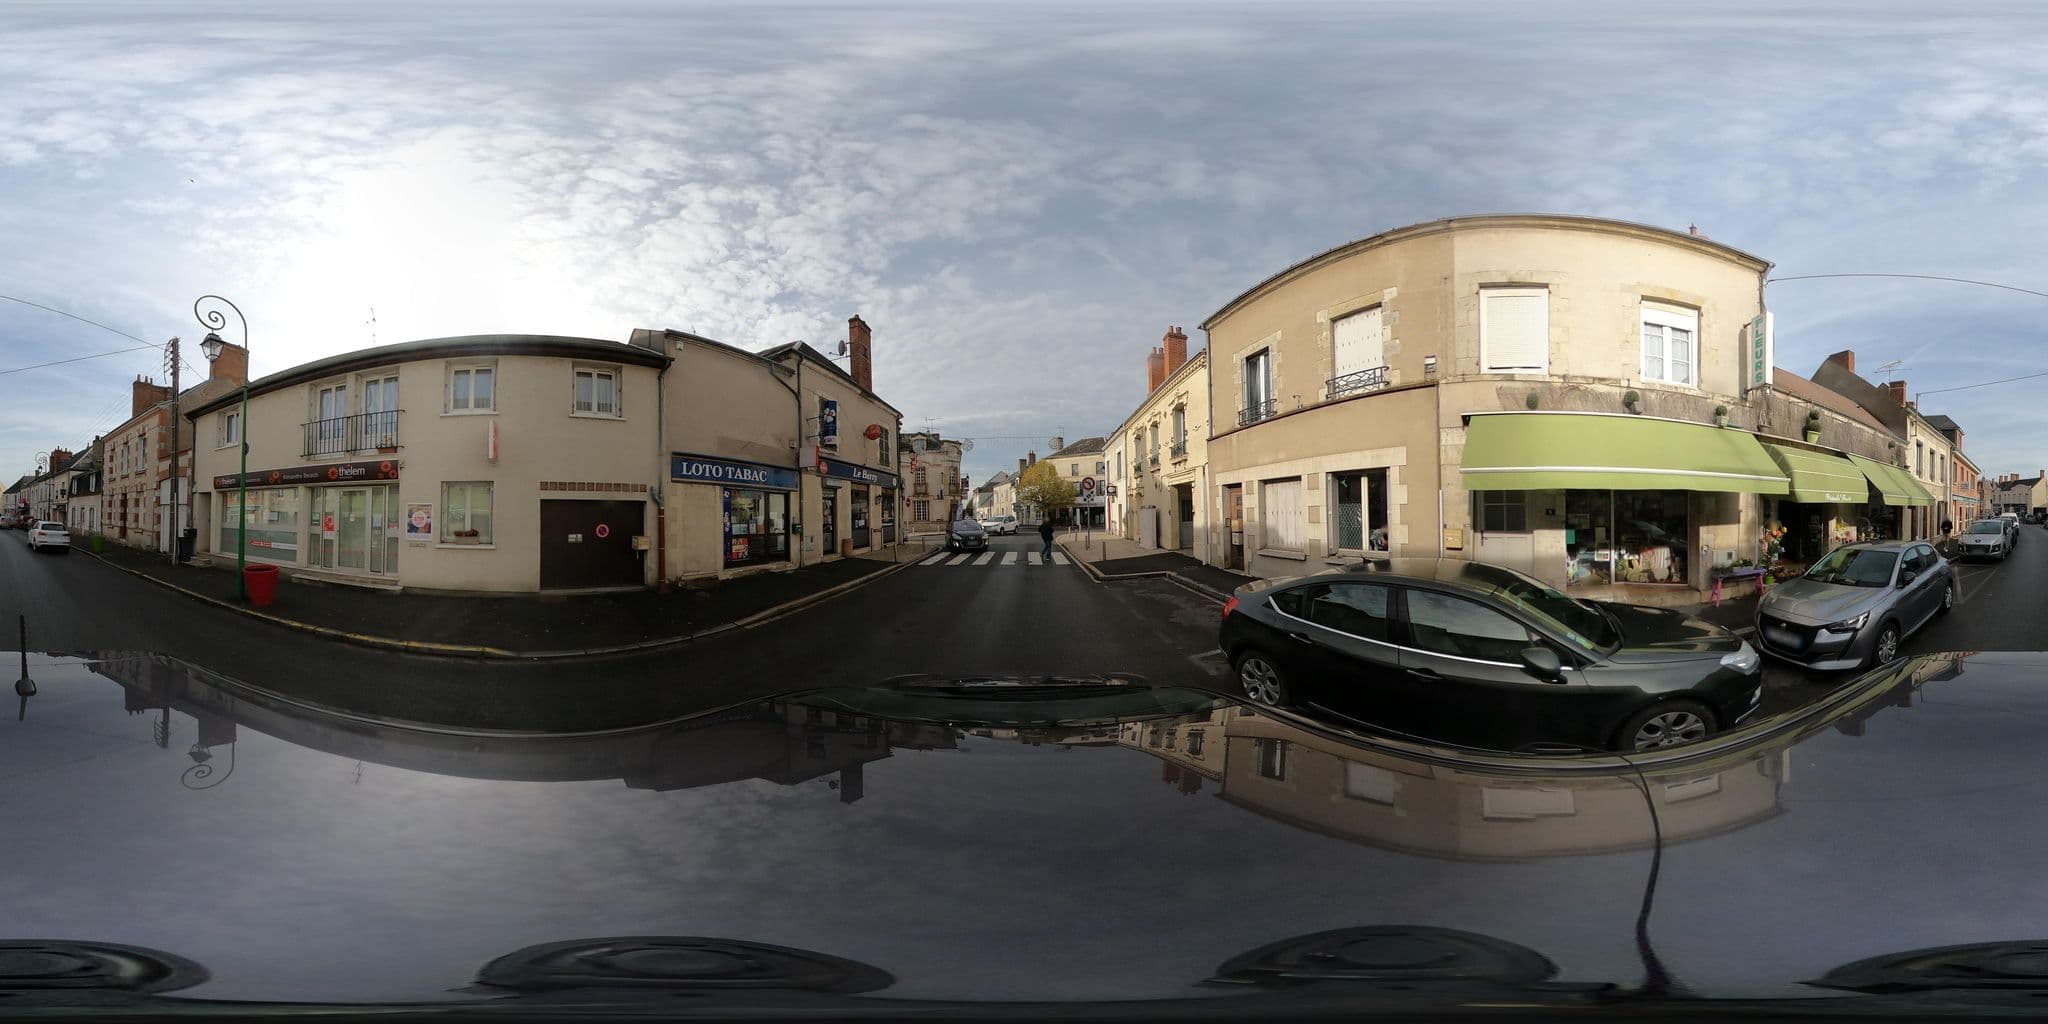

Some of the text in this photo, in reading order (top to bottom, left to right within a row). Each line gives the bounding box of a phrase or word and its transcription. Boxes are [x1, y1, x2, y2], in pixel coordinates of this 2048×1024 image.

[1755, 317, 1763, 383] FLEURS
[682, 461, 767, 482] LOTO TABAC
[853, 467, 877, 483] Le Berry
